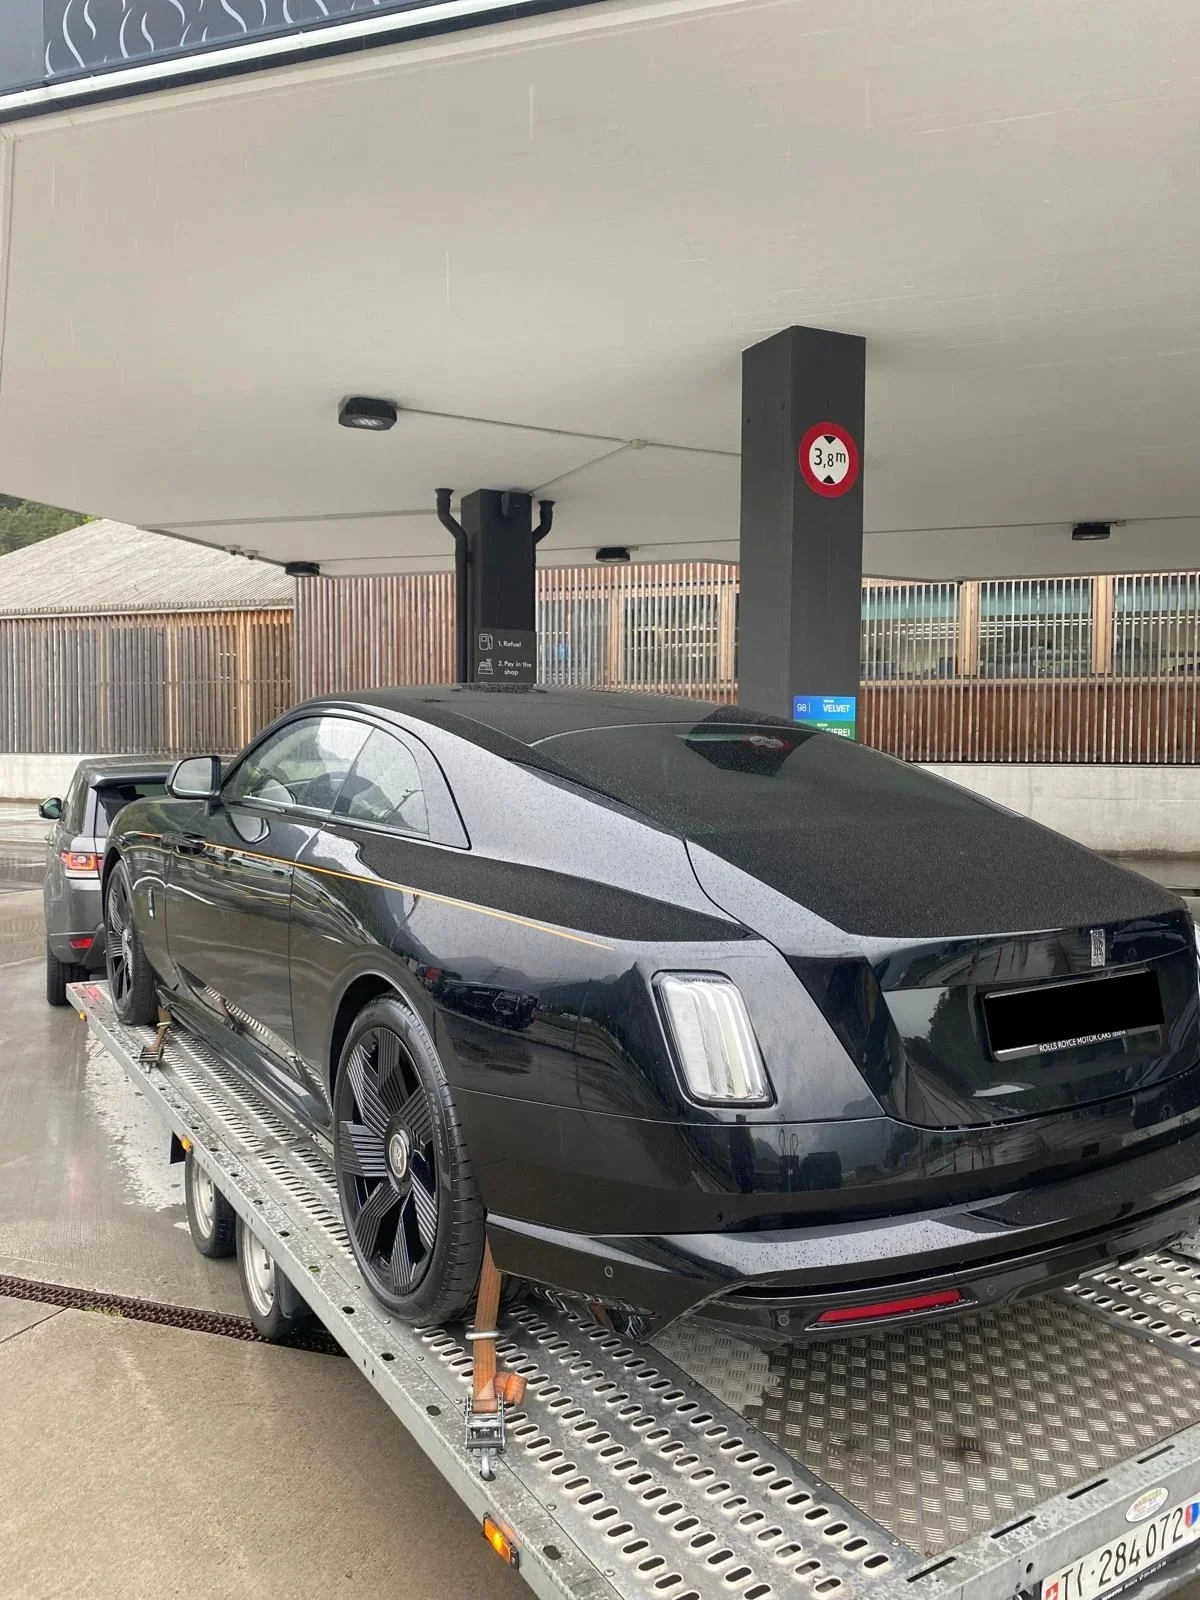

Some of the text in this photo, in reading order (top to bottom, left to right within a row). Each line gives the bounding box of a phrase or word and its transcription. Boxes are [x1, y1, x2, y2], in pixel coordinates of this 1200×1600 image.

[503, 640, 522, 648] Refuel
[504, 660, 515, 668] Pay
[515, 660, 522, 668] in
[796, 703, 850, 713] 98 VELVET
[1039, 1042, 1058, 1052] ROLLS
[1058, 1038, 1076, 1049] ROYCE
[1077, 1034, 1097, 1045] MOTOR
[1097, 1031, 1112, 1041] CARS
